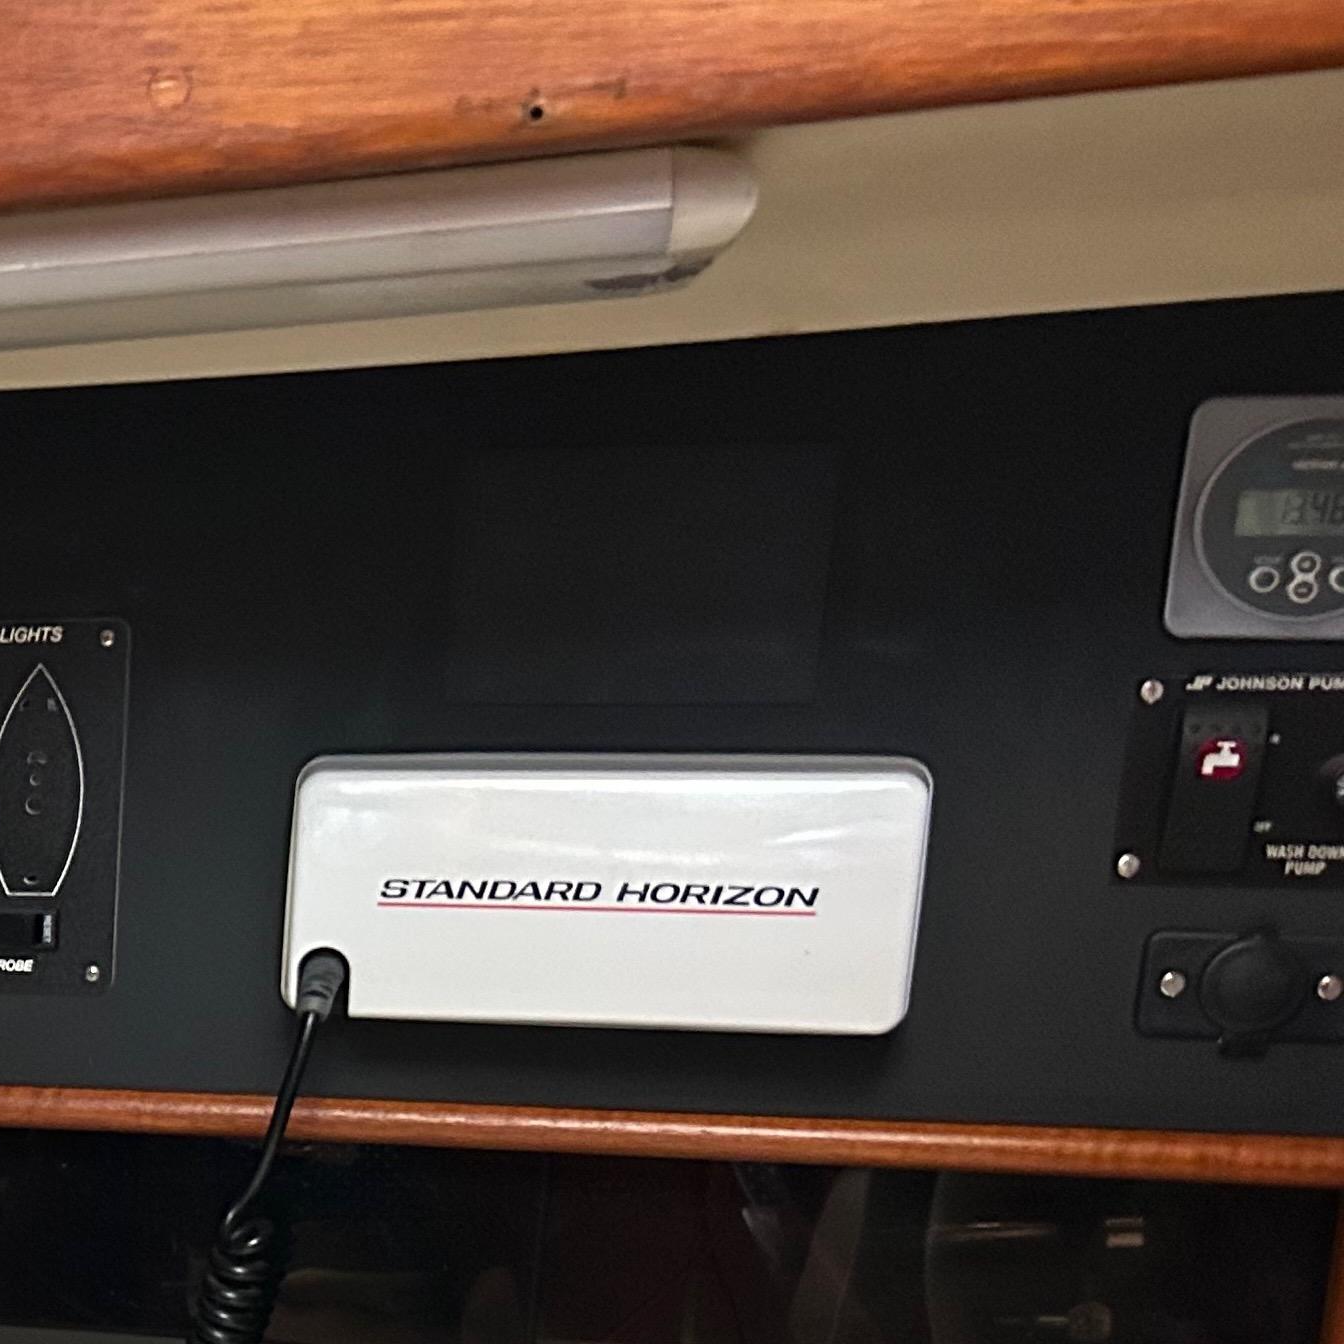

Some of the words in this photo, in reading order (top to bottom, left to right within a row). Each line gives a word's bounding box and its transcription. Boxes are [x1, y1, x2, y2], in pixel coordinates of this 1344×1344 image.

[0, 626, 63, 643] LIGHTS
[1216, 676, 1304, 691] JOHNSON
[1266, 844, 1304, 860] WASH
[378, 877, 603, 903] STANDARD
[616, 882, 820, 909] HORIZON
